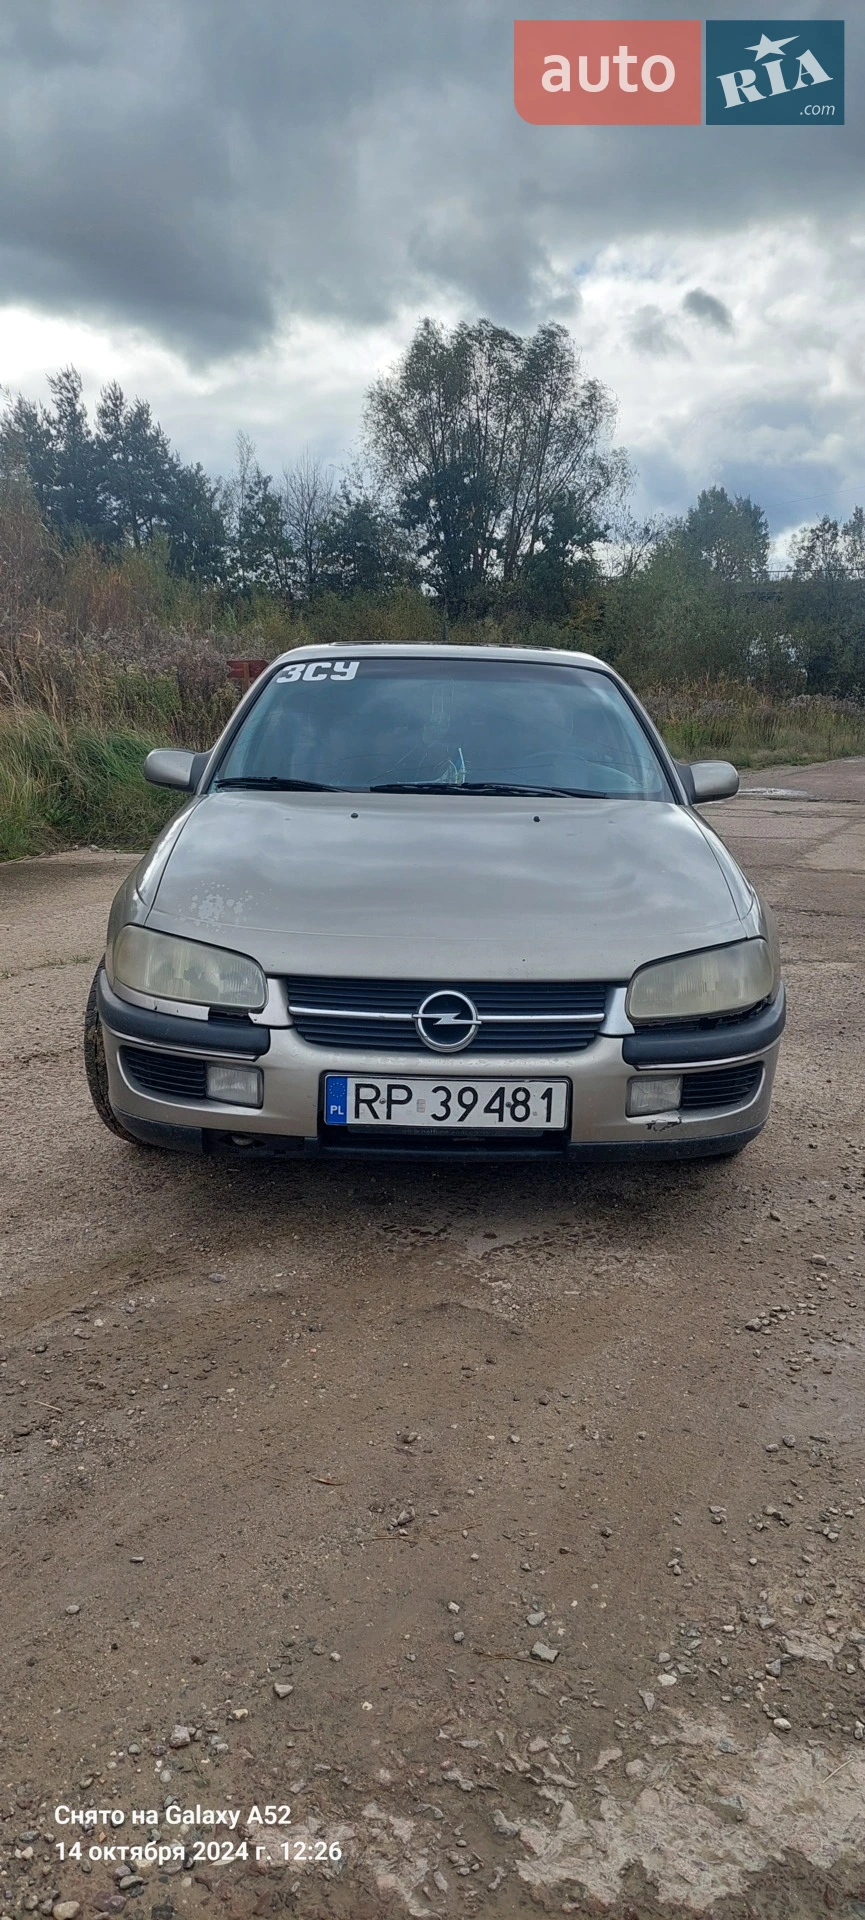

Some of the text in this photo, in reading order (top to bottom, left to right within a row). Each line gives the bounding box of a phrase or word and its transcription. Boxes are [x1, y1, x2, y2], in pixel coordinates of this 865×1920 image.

[276, 661, 360, 684] ЗСУ
[330, 1105, 344, 1116] PL
[354, 1083, 553, 1123] RP 39481
